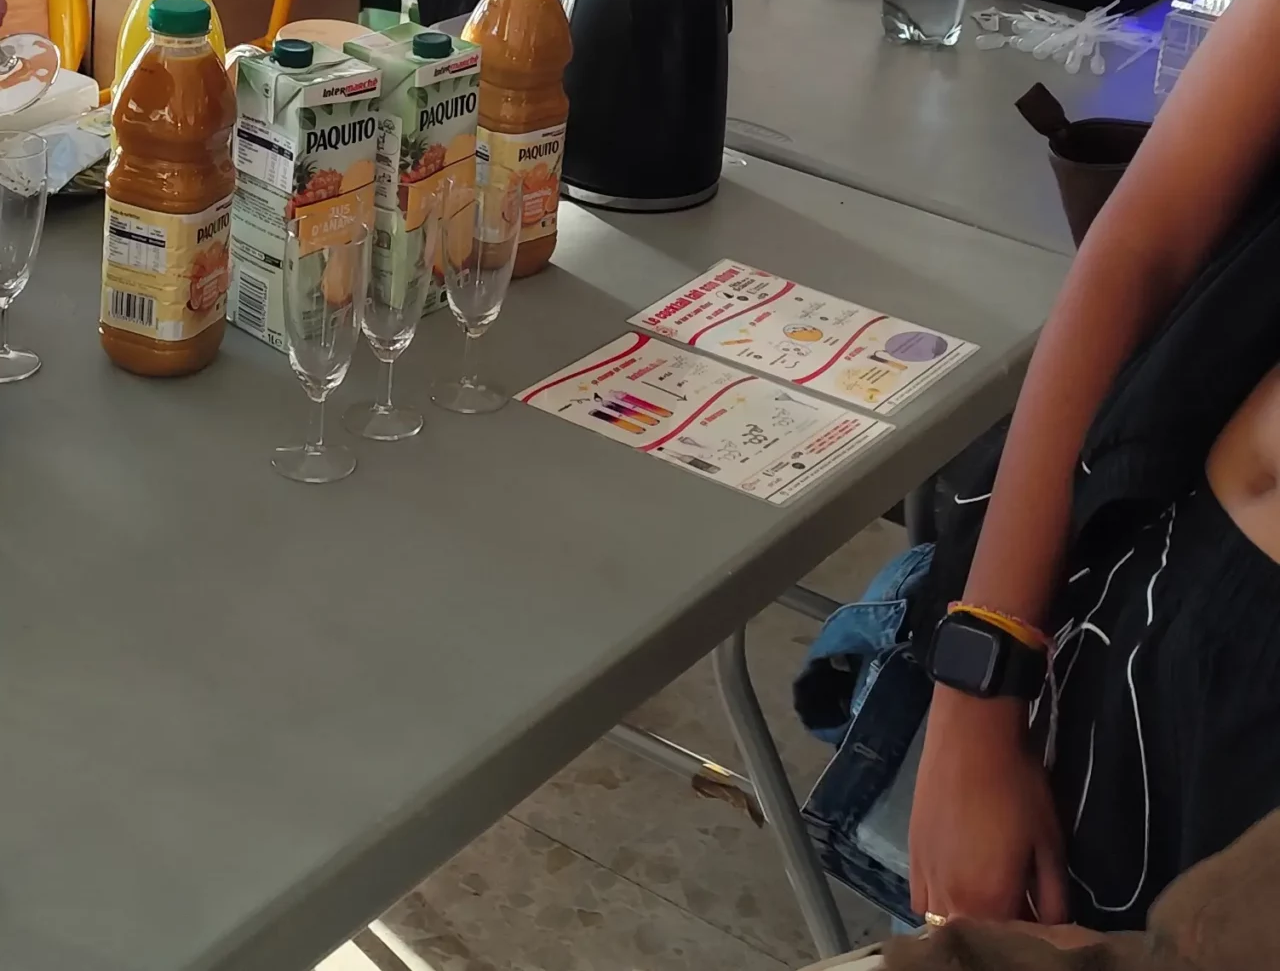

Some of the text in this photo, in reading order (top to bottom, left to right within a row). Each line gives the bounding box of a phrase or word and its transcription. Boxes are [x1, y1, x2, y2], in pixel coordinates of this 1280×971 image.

[420, 92, 477, 132] PAQUITO
[306, 117, 375, 155] PAQUITO
[519, 140, 559, 162] PAQUITO
[197, 212, 230, 244] PAQUITO
